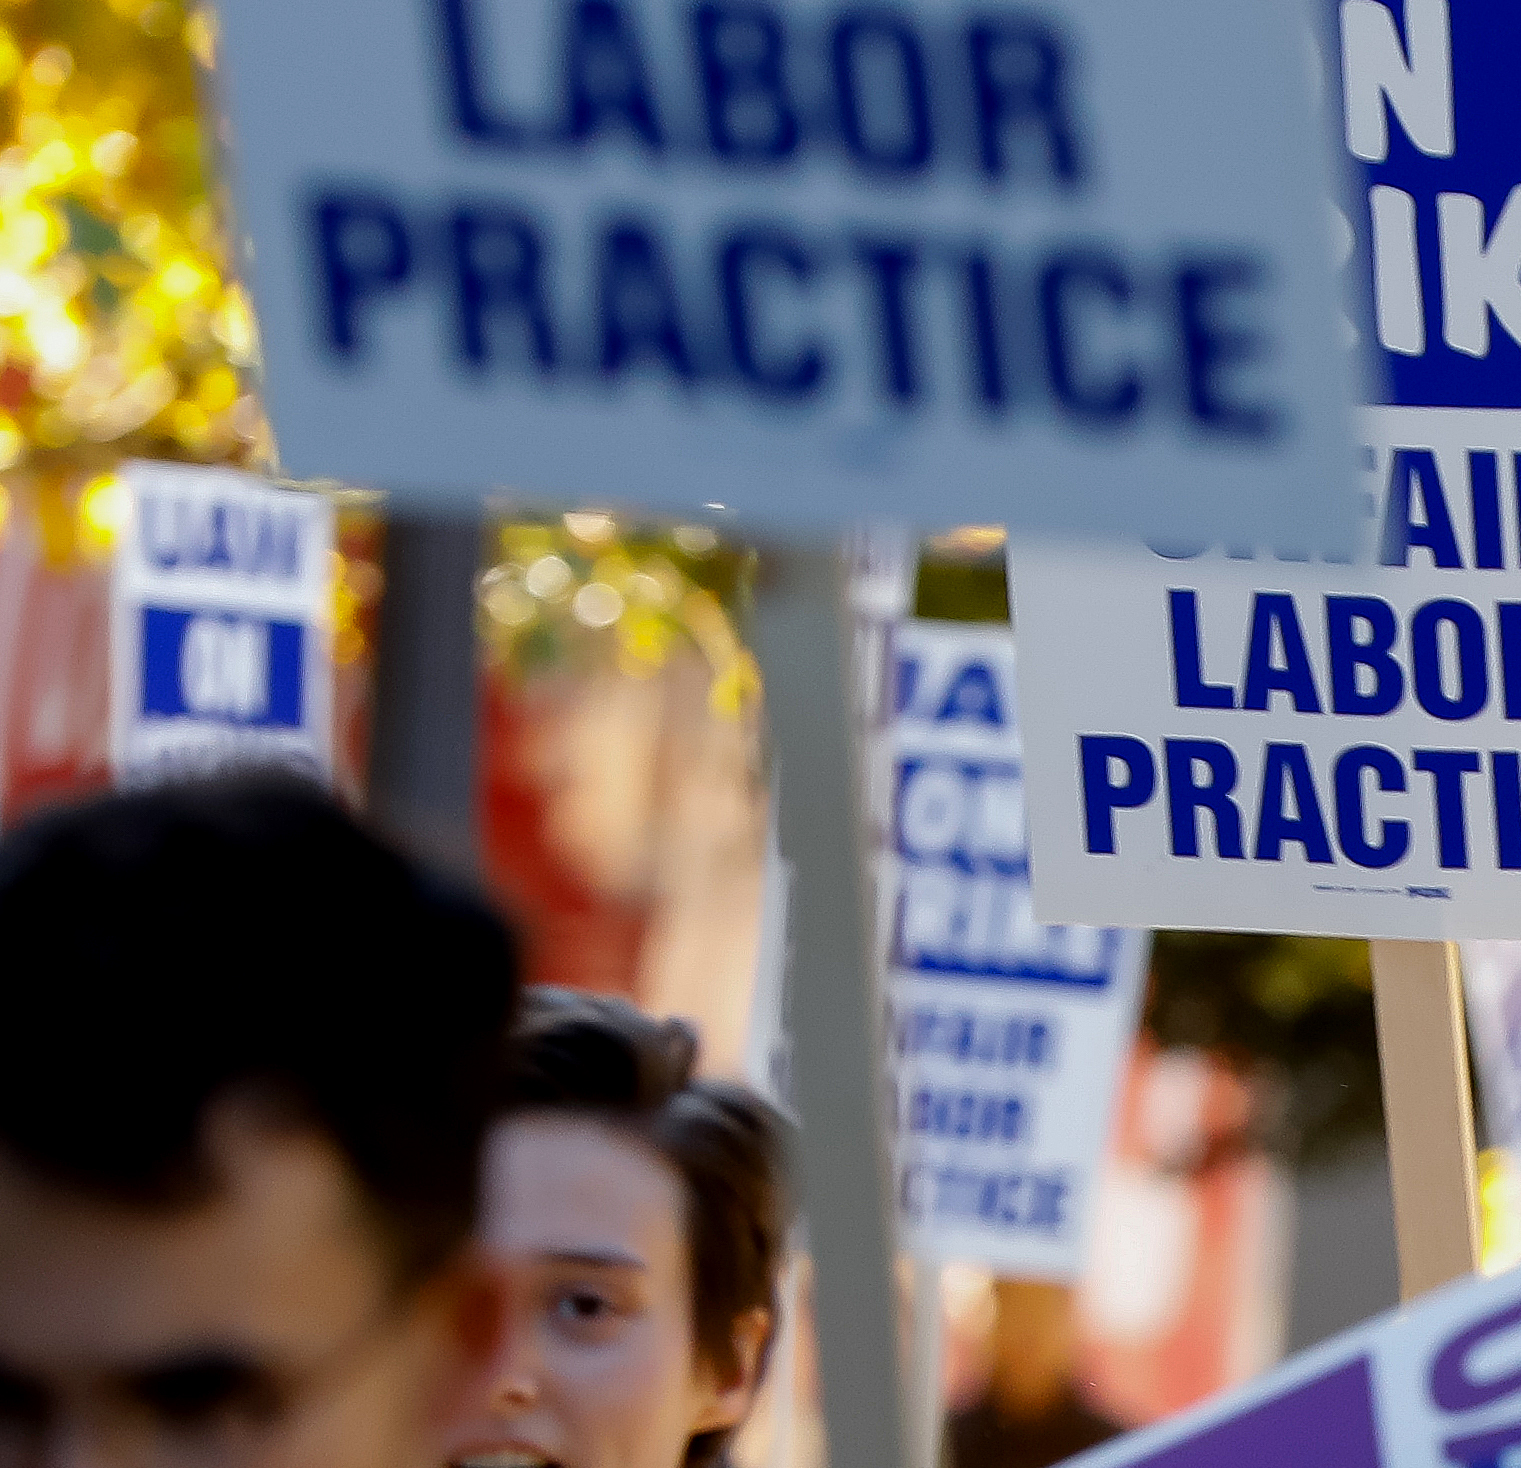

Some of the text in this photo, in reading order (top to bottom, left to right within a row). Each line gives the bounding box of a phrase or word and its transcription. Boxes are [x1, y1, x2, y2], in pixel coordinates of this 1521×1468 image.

[430, 0, 1092, 196] LABOR
[1338, 0, 1455, 160] N
[308, 184, 1282, 438] PRACTICE
